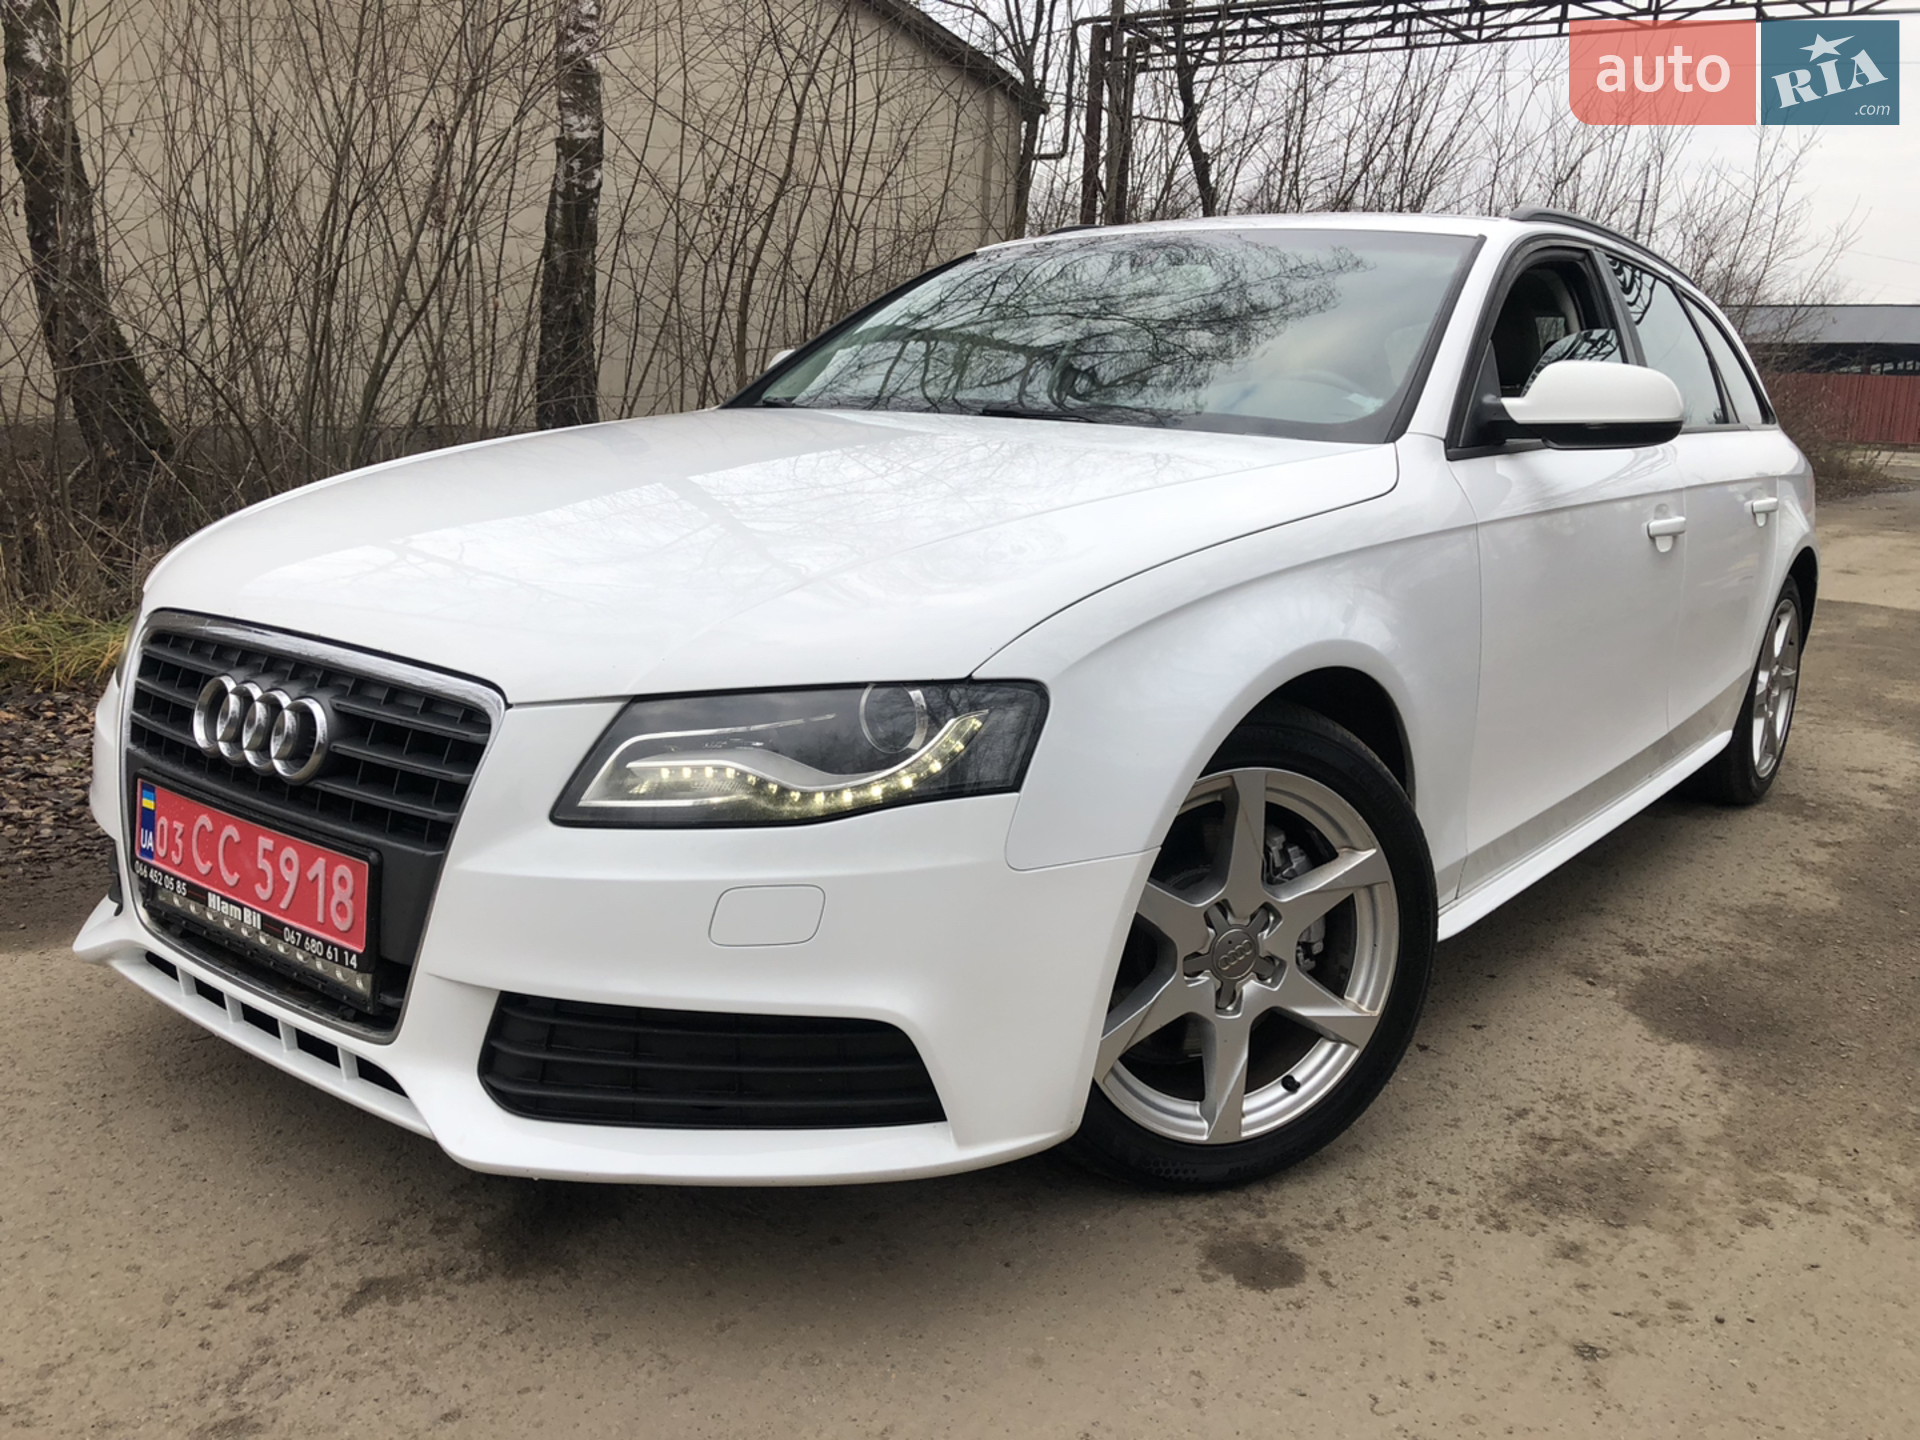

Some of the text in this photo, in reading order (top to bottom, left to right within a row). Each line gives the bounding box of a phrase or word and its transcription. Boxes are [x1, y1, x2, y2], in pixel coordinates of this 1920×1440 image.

[141, 828, 154, 852] UA
[156, 814, 355, 932] 03 CC 5918
[149, 868, 163, 886] 452
[164, 875, 174, 891] 05
[176, 880, 187, 896] 85
[283, 926, 302, 947] 067
[304, 936, 324, 956] 680
[326, 945, 339, 963] 61
[343, 951, 357, 969] 14
